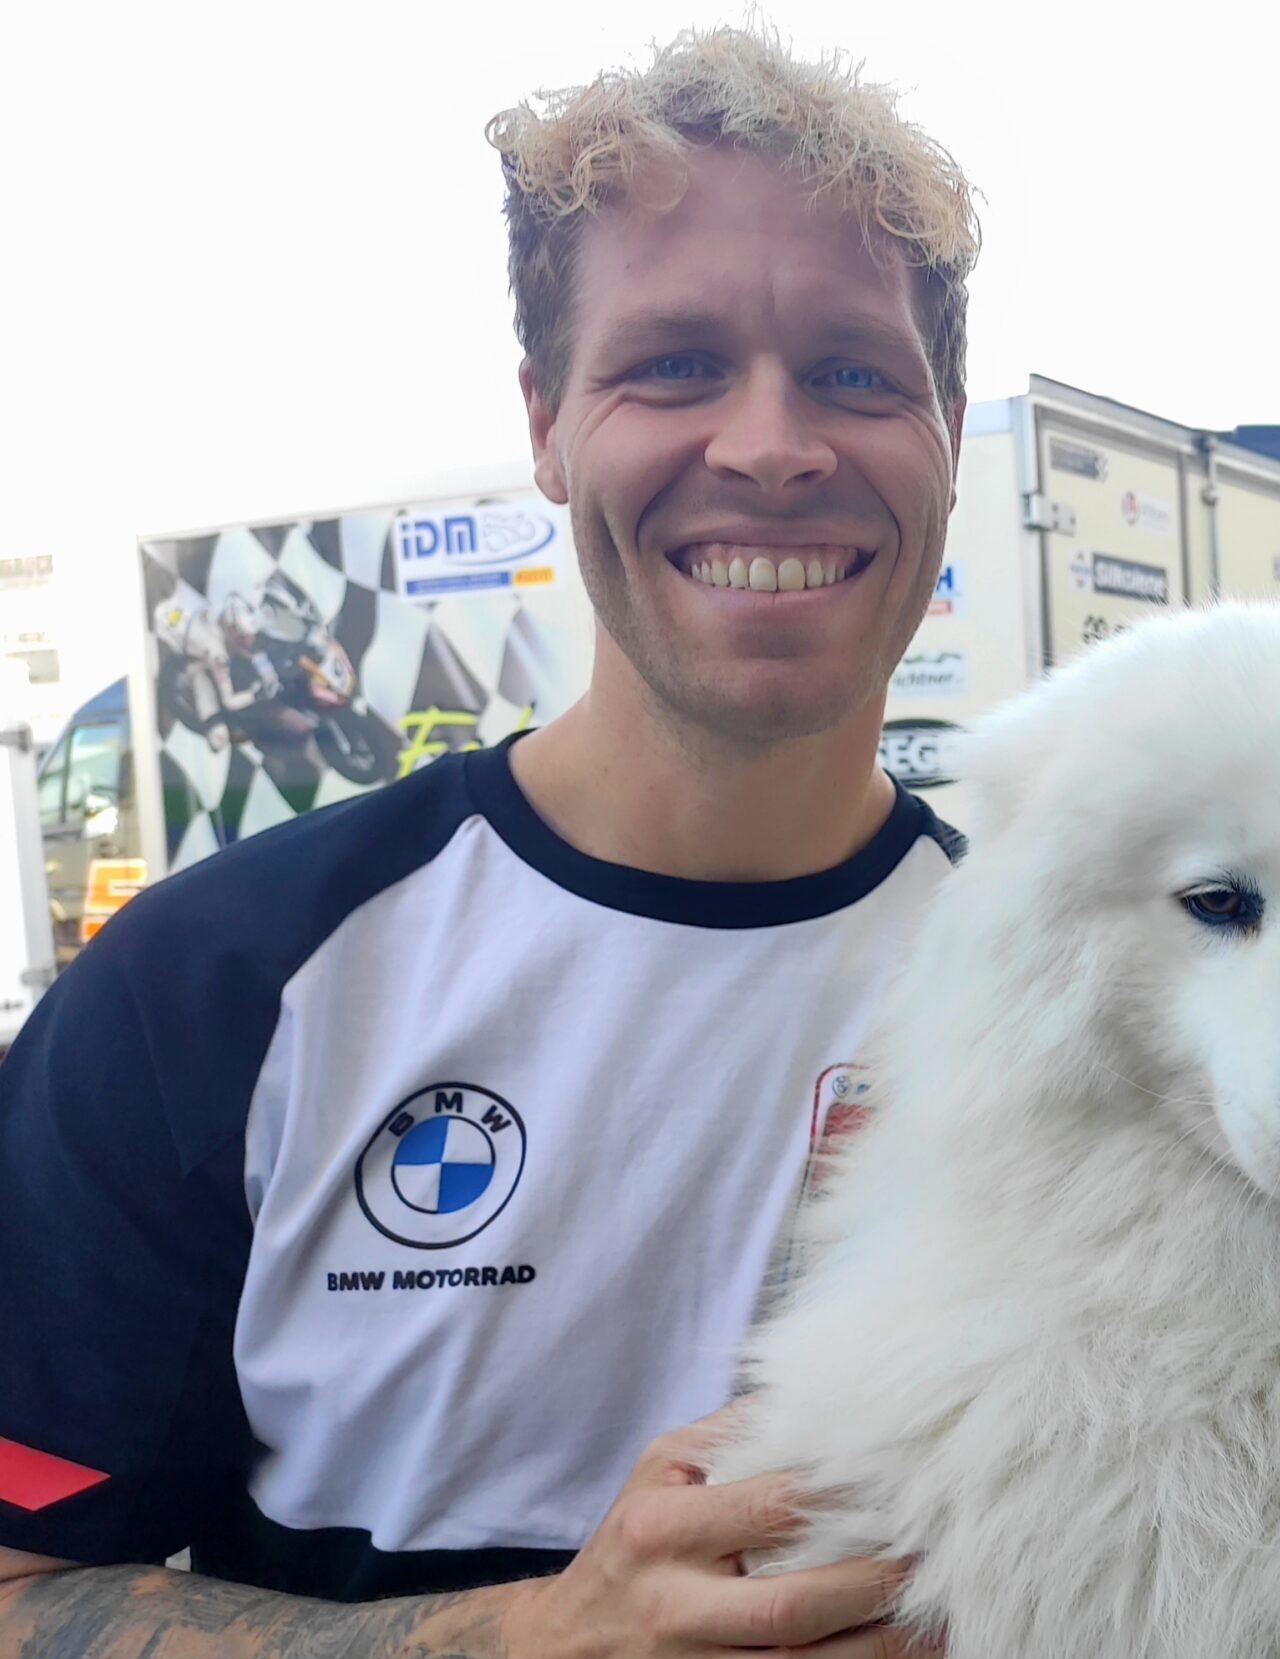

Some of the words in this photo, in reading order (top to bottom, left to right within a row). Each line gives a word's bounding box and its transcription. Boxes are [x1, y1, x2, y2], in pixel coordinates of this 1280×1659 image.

[388, 1092, 511, 1136] BMW
[327, 1271, 385, 1291] BMW
[392, 1265, 536, 1290] MOTORRAD
